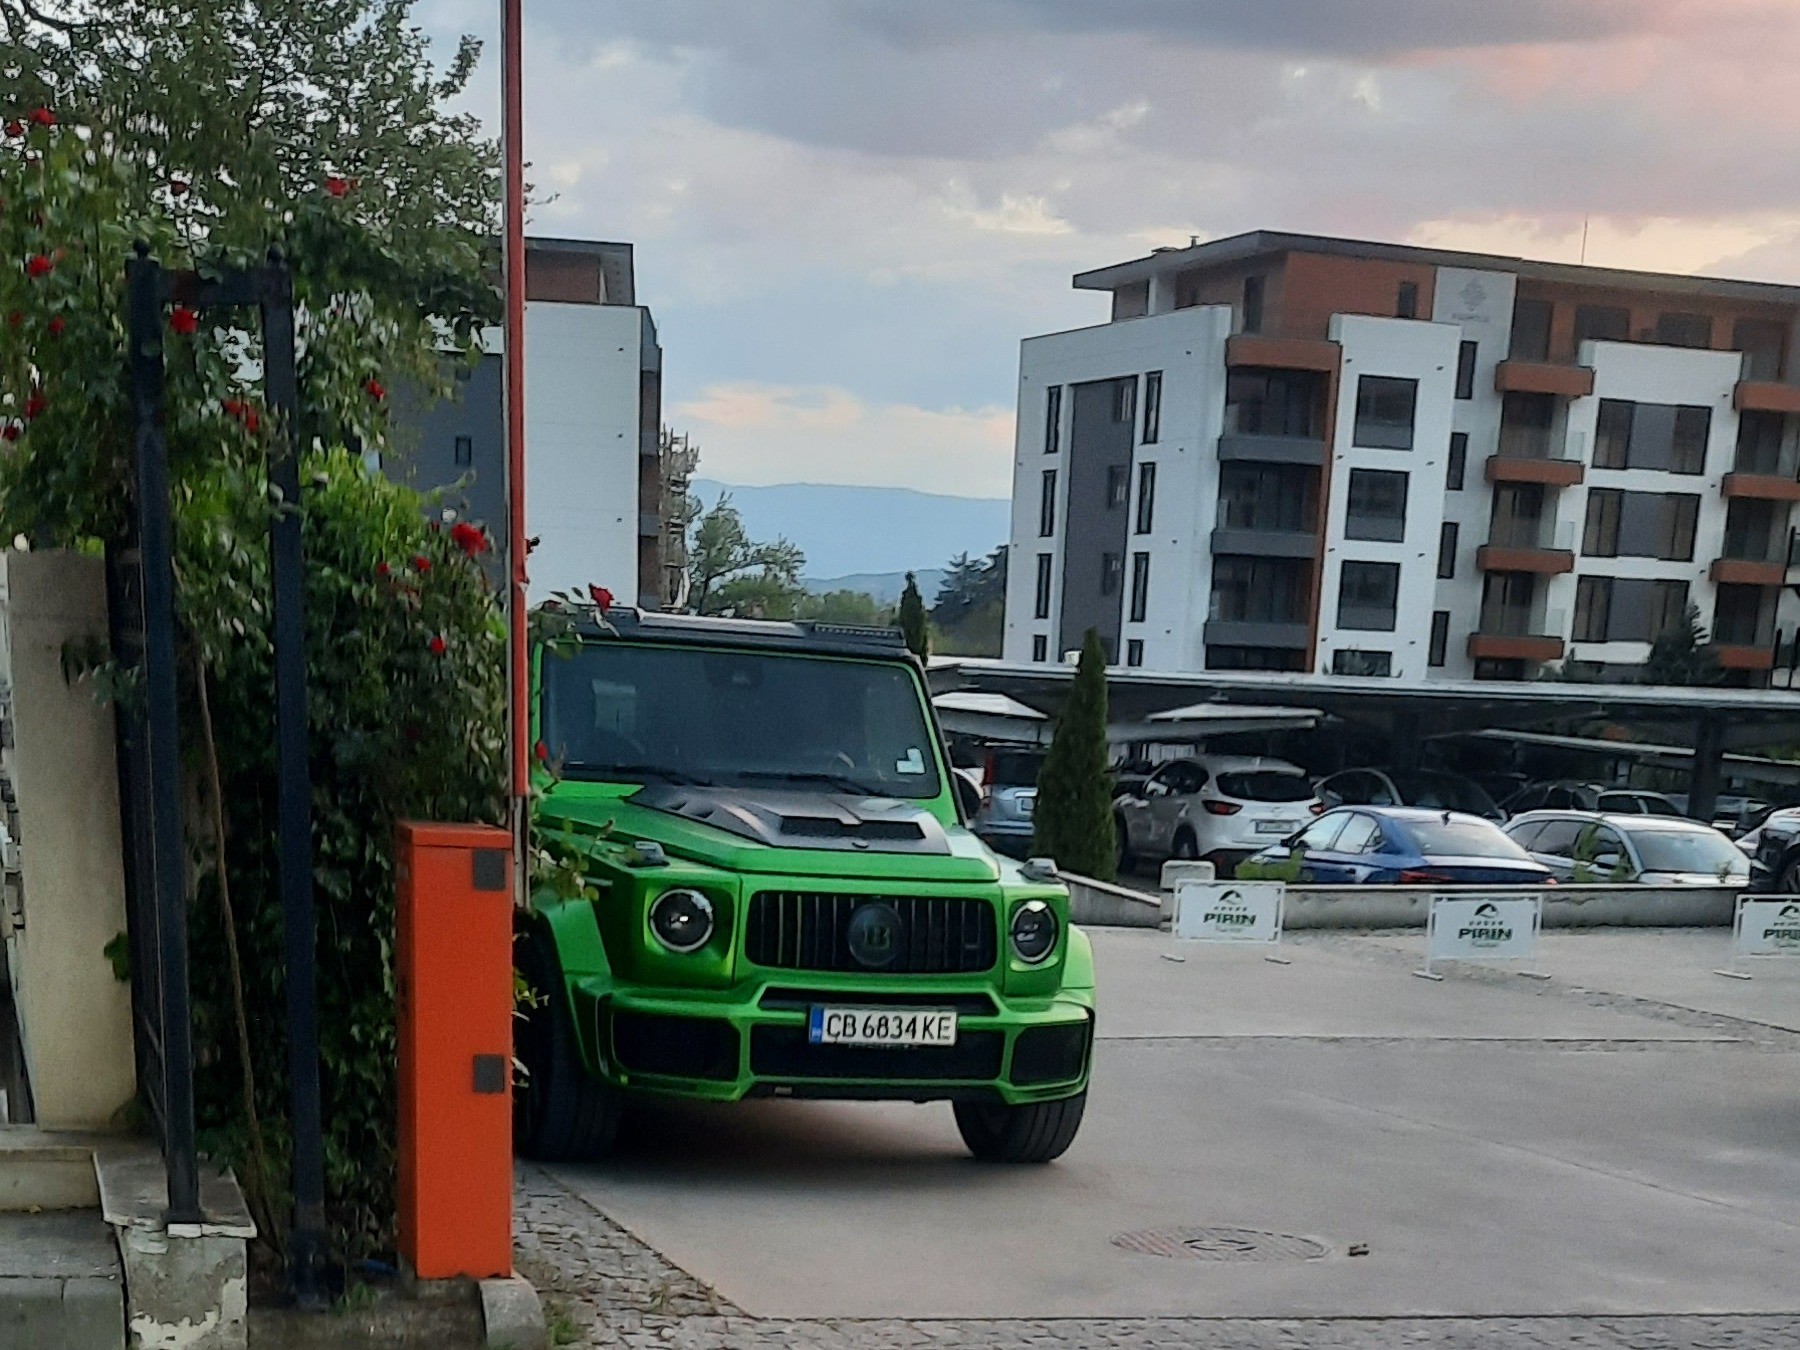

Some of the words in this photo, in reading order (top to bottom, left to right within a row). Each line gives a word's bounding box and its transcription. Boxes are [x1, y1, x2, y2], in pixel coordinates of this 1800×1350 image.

[1203, 913, 1257, 925] PIRIN
[1458, 928, 1512, 940] PIRIN
[827, 1013, 857, 1039] CB
[862, 1014, 918, 1040] 6834
[922, 1016, 952, 1041] KE
